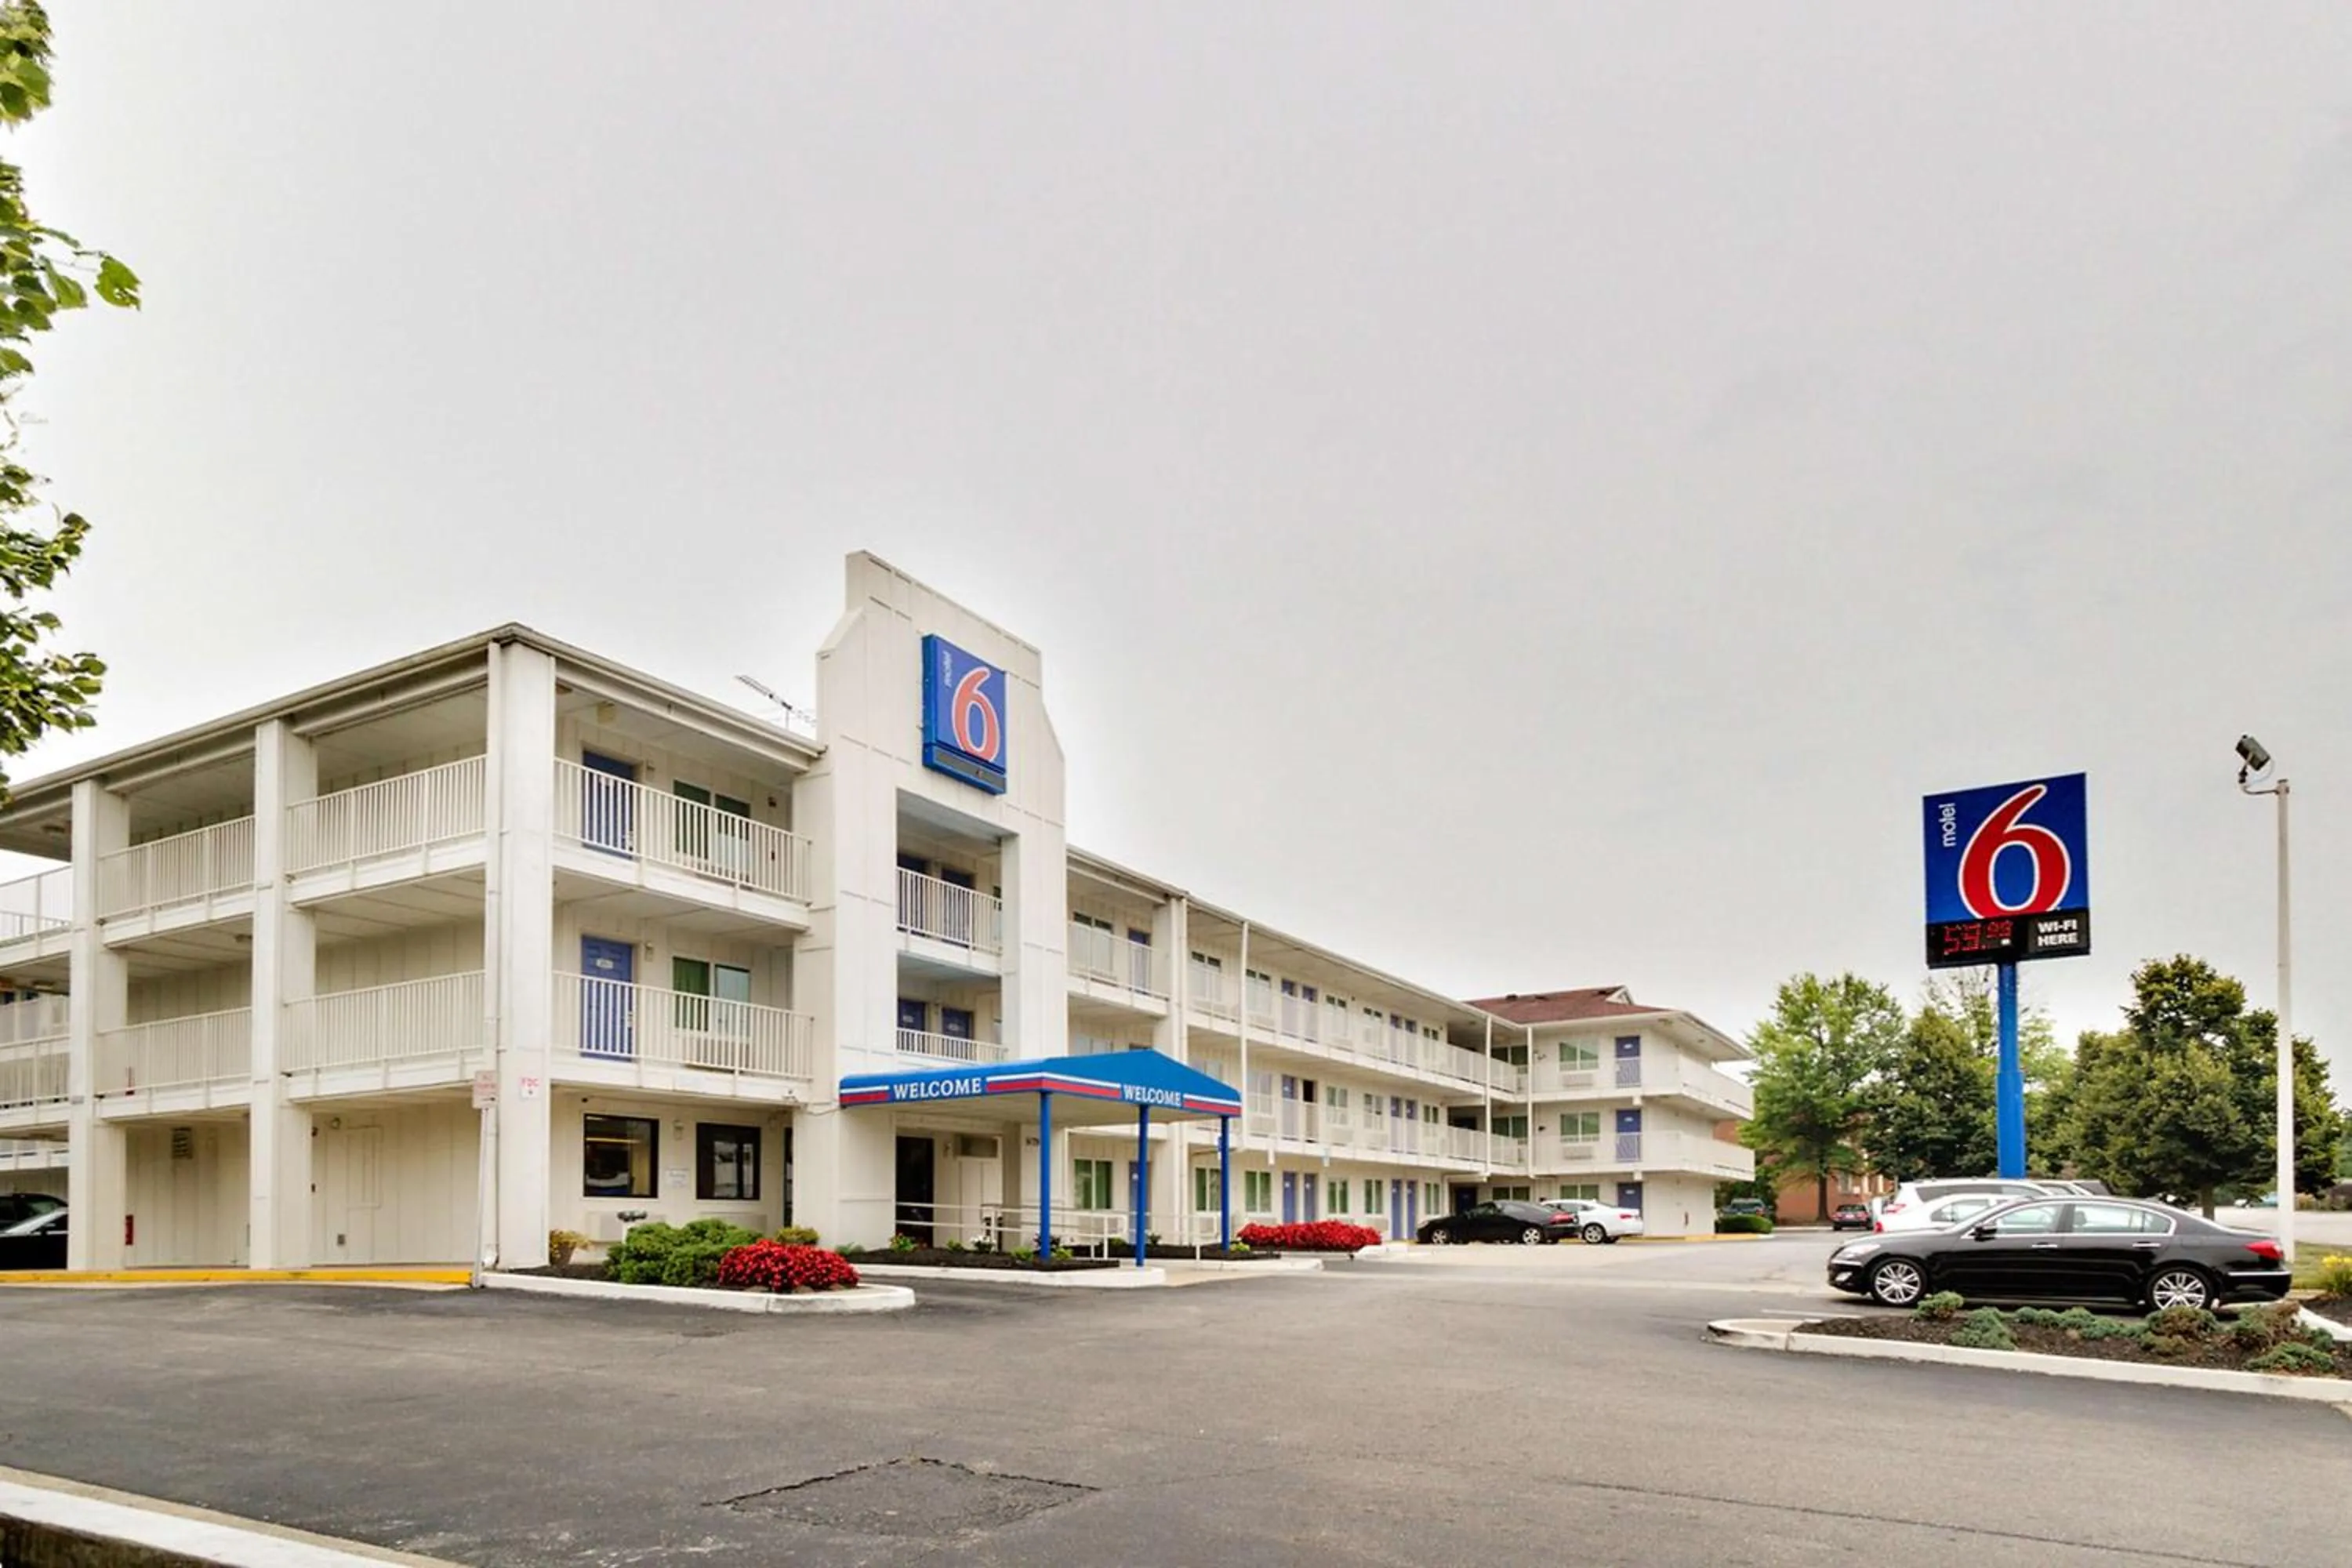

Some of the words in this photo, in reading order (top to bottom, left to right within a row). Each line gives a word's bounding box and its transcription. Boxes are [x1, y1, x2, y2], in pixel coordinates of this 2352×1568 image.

[952, 666, 1000, 762] 6
[1939, 803, 1956, 848] motel
[1958, 784, 2072, 920] 6
[2038, 919, 2078, 934] WI-FI
[2038, 932, 2079, 947] HERE
[893, 1077, 982, 1100] WELCOME
[1123, 1084, 1181, 1107] WELCOME
